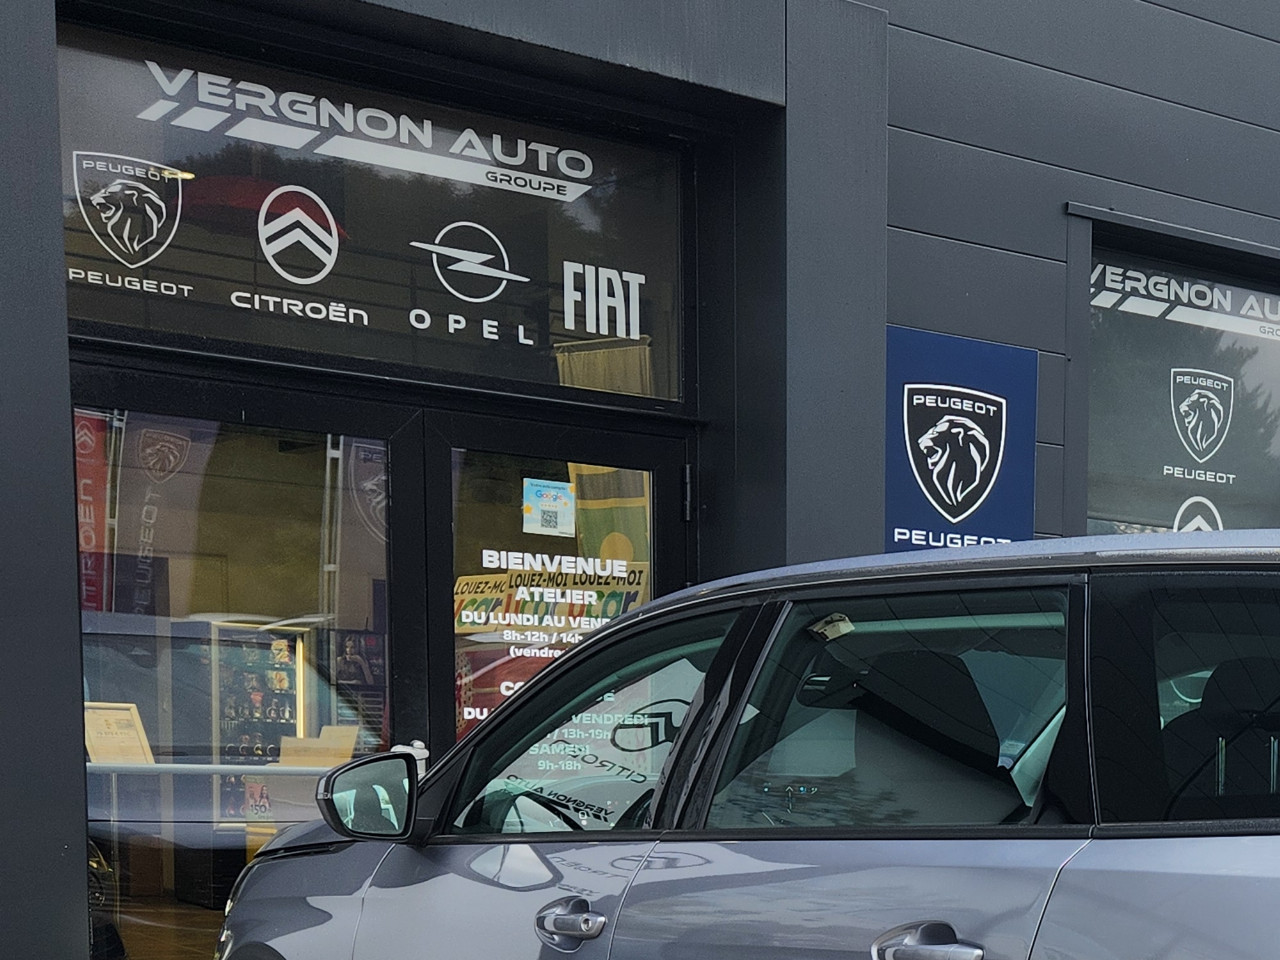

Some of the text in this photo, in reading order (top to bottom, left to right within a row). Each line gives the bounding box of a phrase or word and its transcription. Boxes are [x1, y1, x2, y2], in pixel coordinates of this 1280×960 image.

[145, 60, 593, 180] VERGNON AUTO
[82, 160, 171, 183] PEUGEOT
[485, 170, 568, 196] GROUPE
[68, 268, 194, 297] PEUGEOT
[563, 261, 645, 340] FIAT
[409, 309, 534, 345] OPEL
[1176, 375, 1229, 391] PEUGEOT
[913, 395, 997, 416] PEUGEOT
[1163, 465, 1236, 484] PEUGEOT
[894, 528, 1011, 547] PEUGE
[482, 549, 627, 577] BIENVENUE
[509, 573, 568, 588] LOUEZ-MOI
[515, 587, 597, 605] ATELIER
[462, 611, 486, 623] DU
[489, 612, 538, 626] LUNDI
[542, 615, 565, 628] AU
[503, 630, 549, 642] 8h-12h
[464, 707, 488, 720] DU
[572, 713, 649, 725] VENDREDI
[529, 743, 590, 755] SAMEDI
[537, 760, 582, 771] 9h-18h
